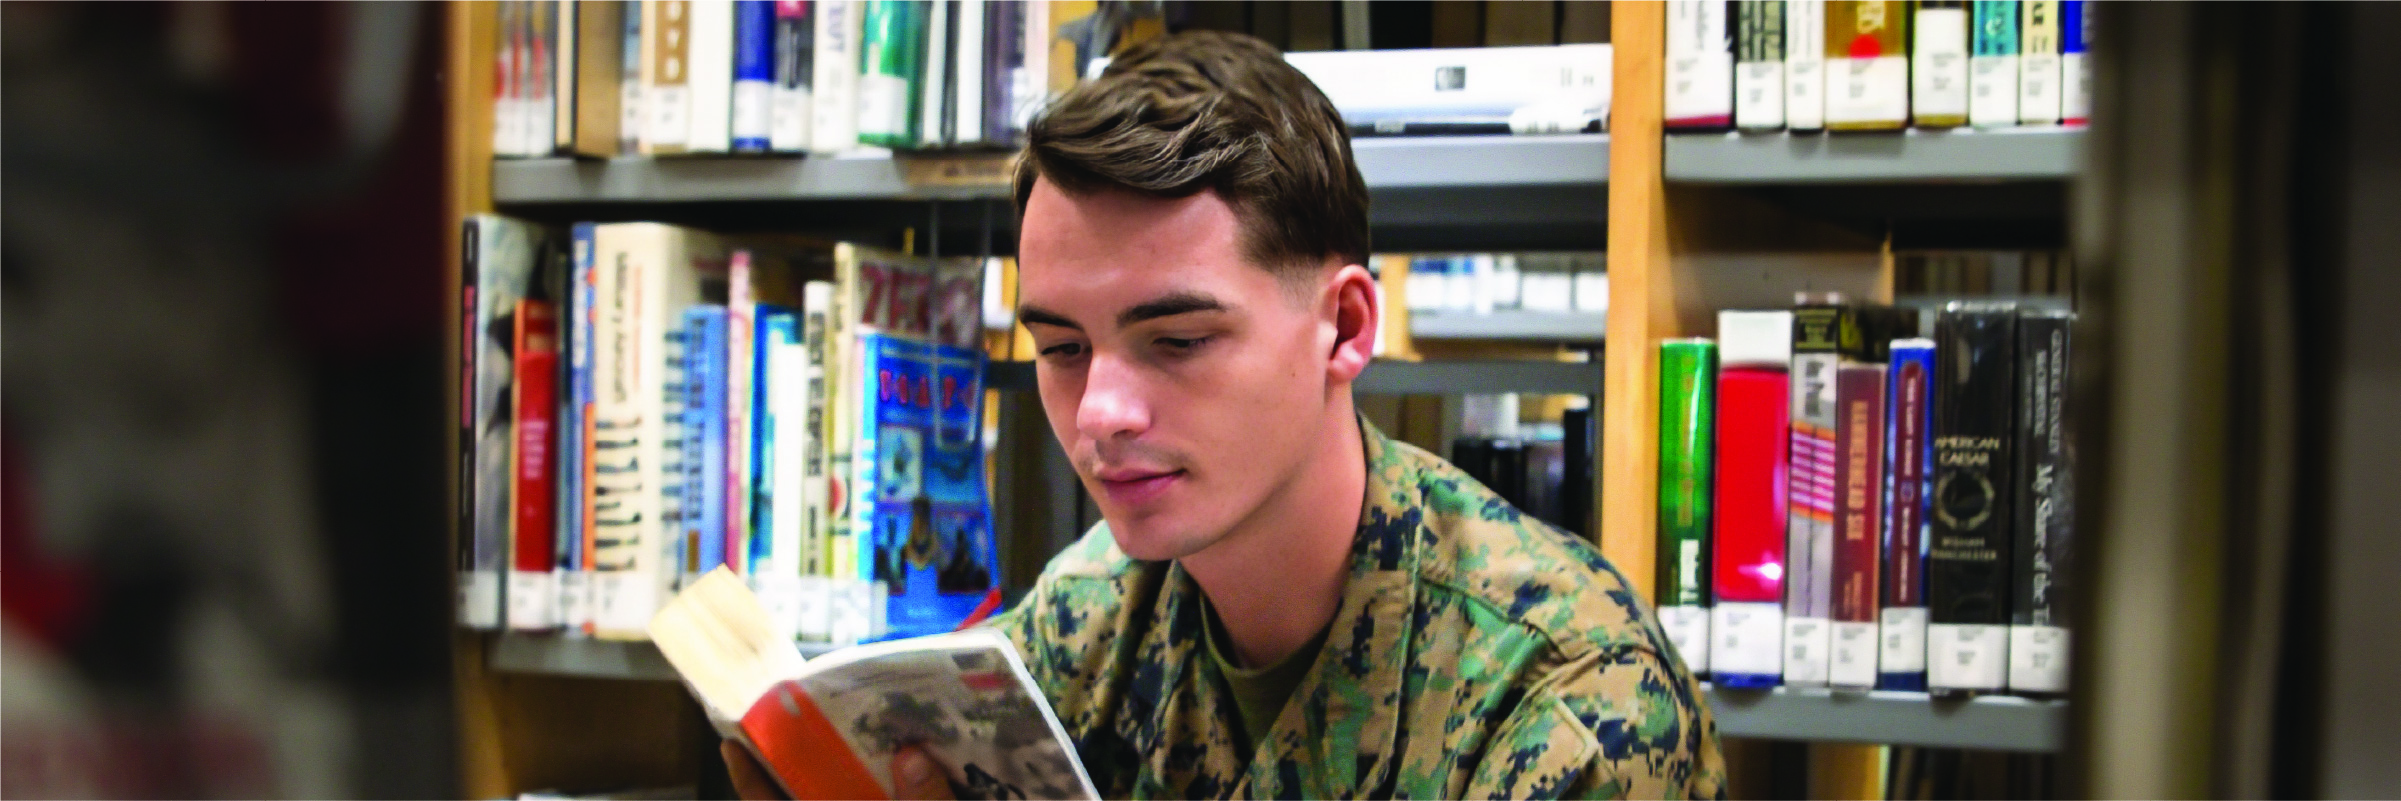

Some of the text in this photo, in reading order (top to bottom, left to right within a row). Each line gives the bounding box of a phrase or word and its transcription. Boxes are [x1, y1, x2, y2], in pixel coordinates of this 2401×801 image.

[1934, 435, 2001, 450] AMERICAN
[1939, 451, 1990, 467] CAESAR
[2031, 463, 2054, 492] My
[2033, 496, 2054, 548] Share
[2033, 551, 2053, 572] of
[2033, 572, 2052, 602] the
